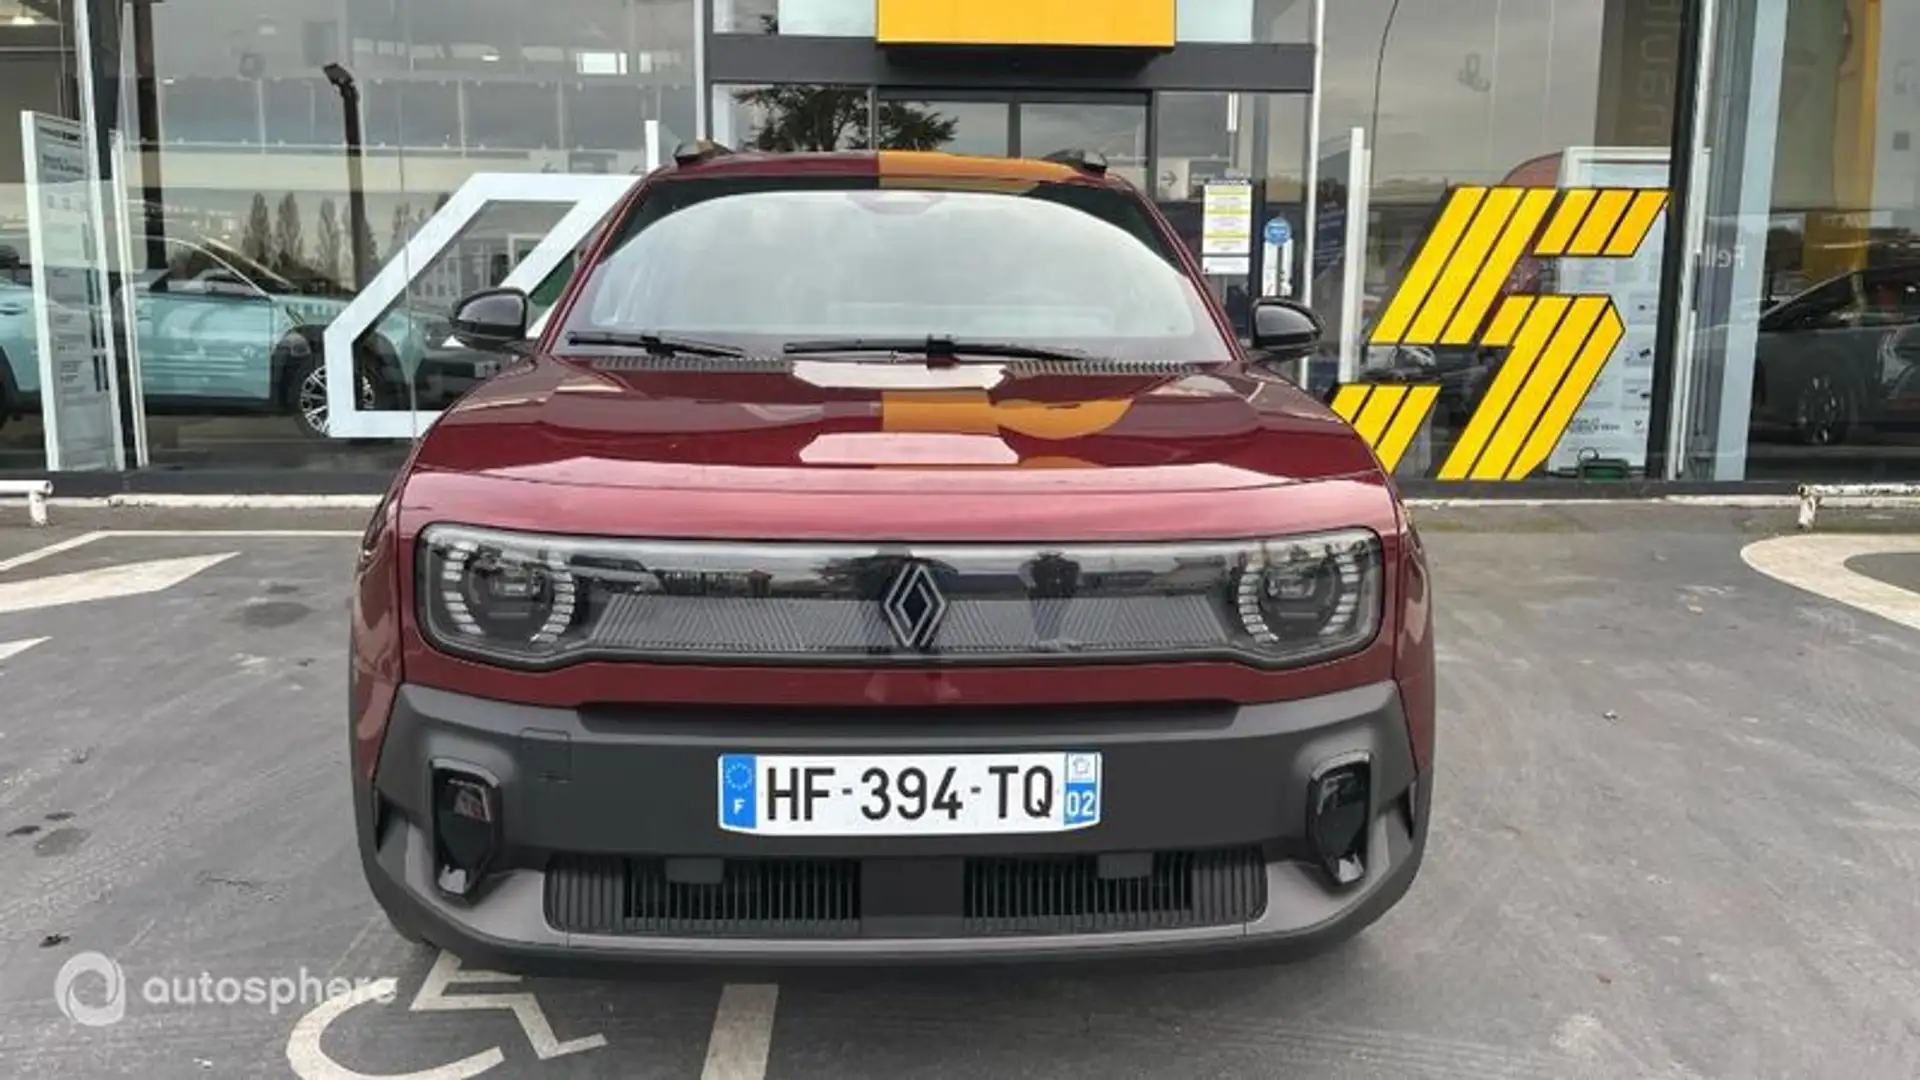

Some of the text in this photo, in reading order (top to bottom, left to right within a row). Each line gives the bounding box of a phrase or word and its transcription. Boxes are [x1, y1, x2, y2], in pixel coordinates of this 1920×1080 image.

[734, 764, 1095, 821] F HF-394-TQ 02
